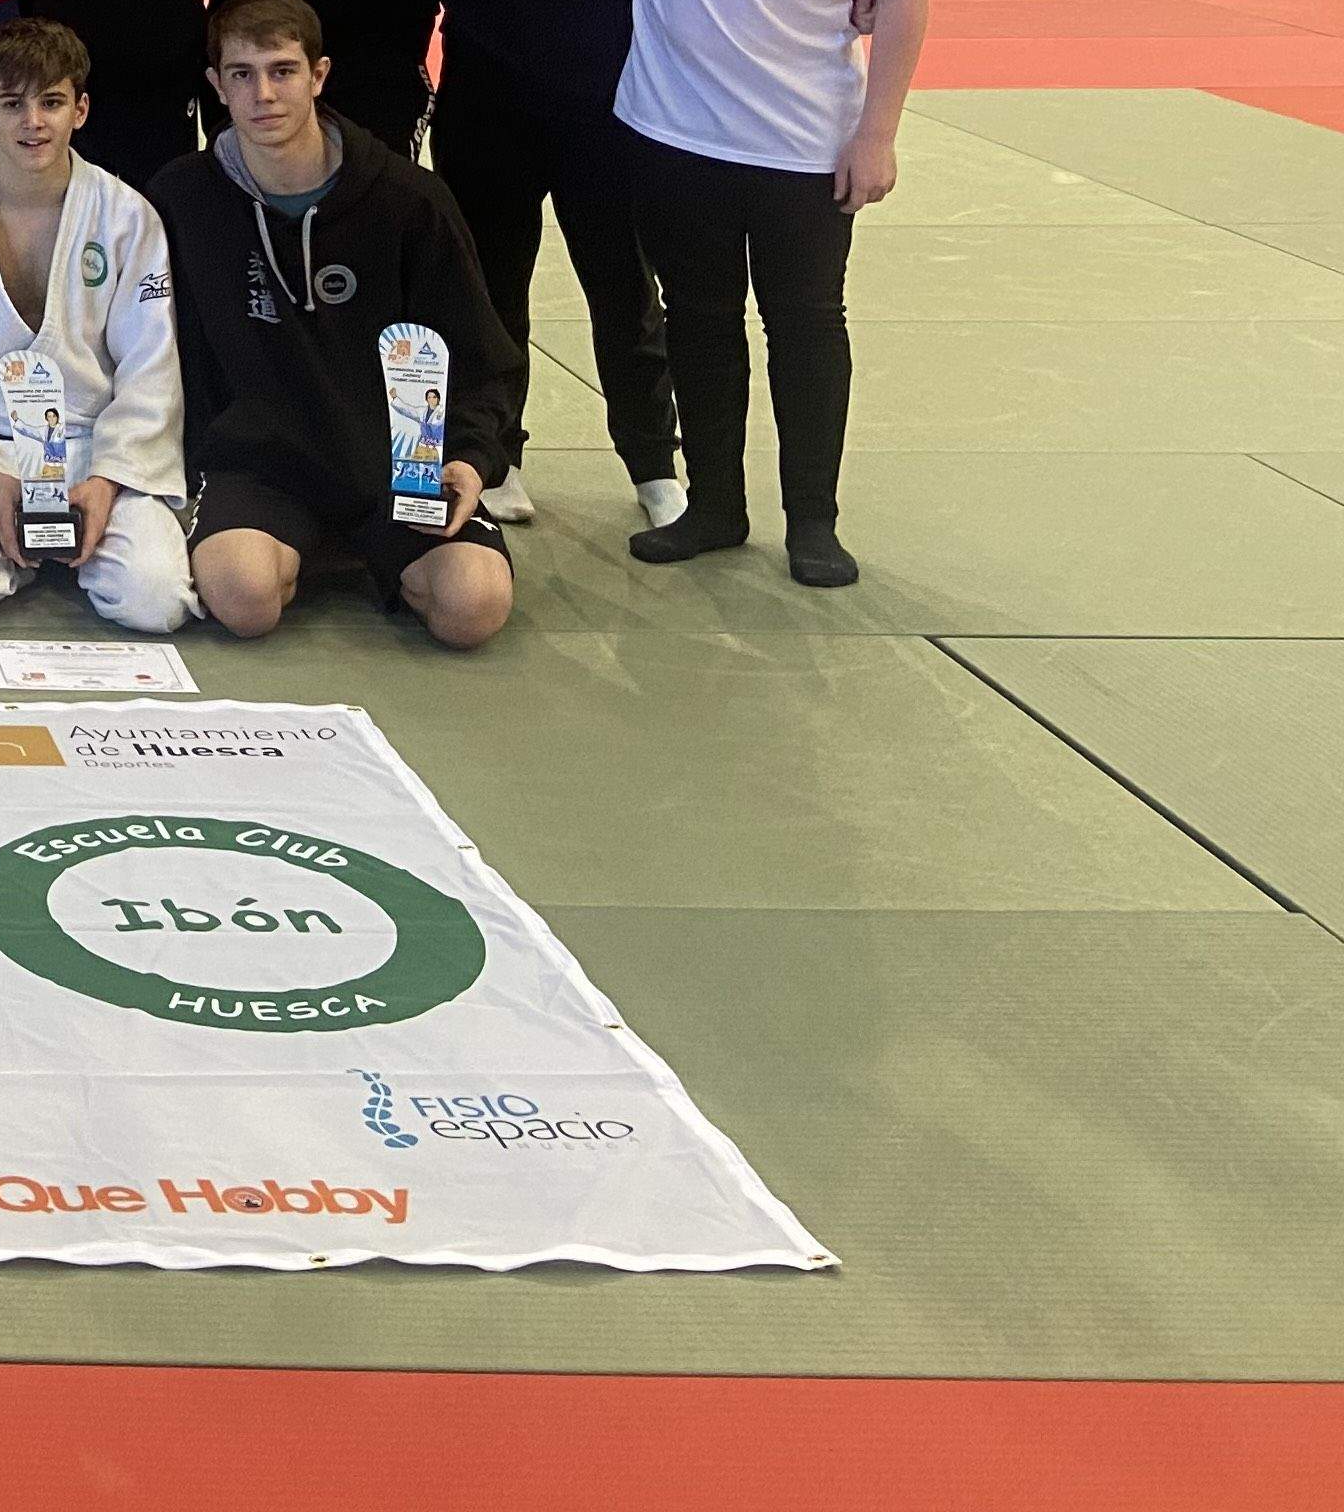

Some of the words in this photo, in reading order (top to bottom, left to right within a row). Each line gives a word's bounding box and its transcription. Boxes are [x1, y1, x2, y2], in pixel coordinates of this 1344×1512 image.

[69, 724, 338, 745] Ayuntamiento
[75, 741, 111, 758] de
[121, 742, 284, 758] Huesca
[83, 758, 175, 770] Deportes
[12, 819, 206, 865] Escuela
[234, 826, 350, 869] Club
[100, 896, 343, 935] Ibón
[168, 991, 388, 1023] HUESCA
[409, 1094, 539, 1118] FISIO
[430, 1111, 634, 1150] espacio
[157, 1178, 410, 1224] Hobby
